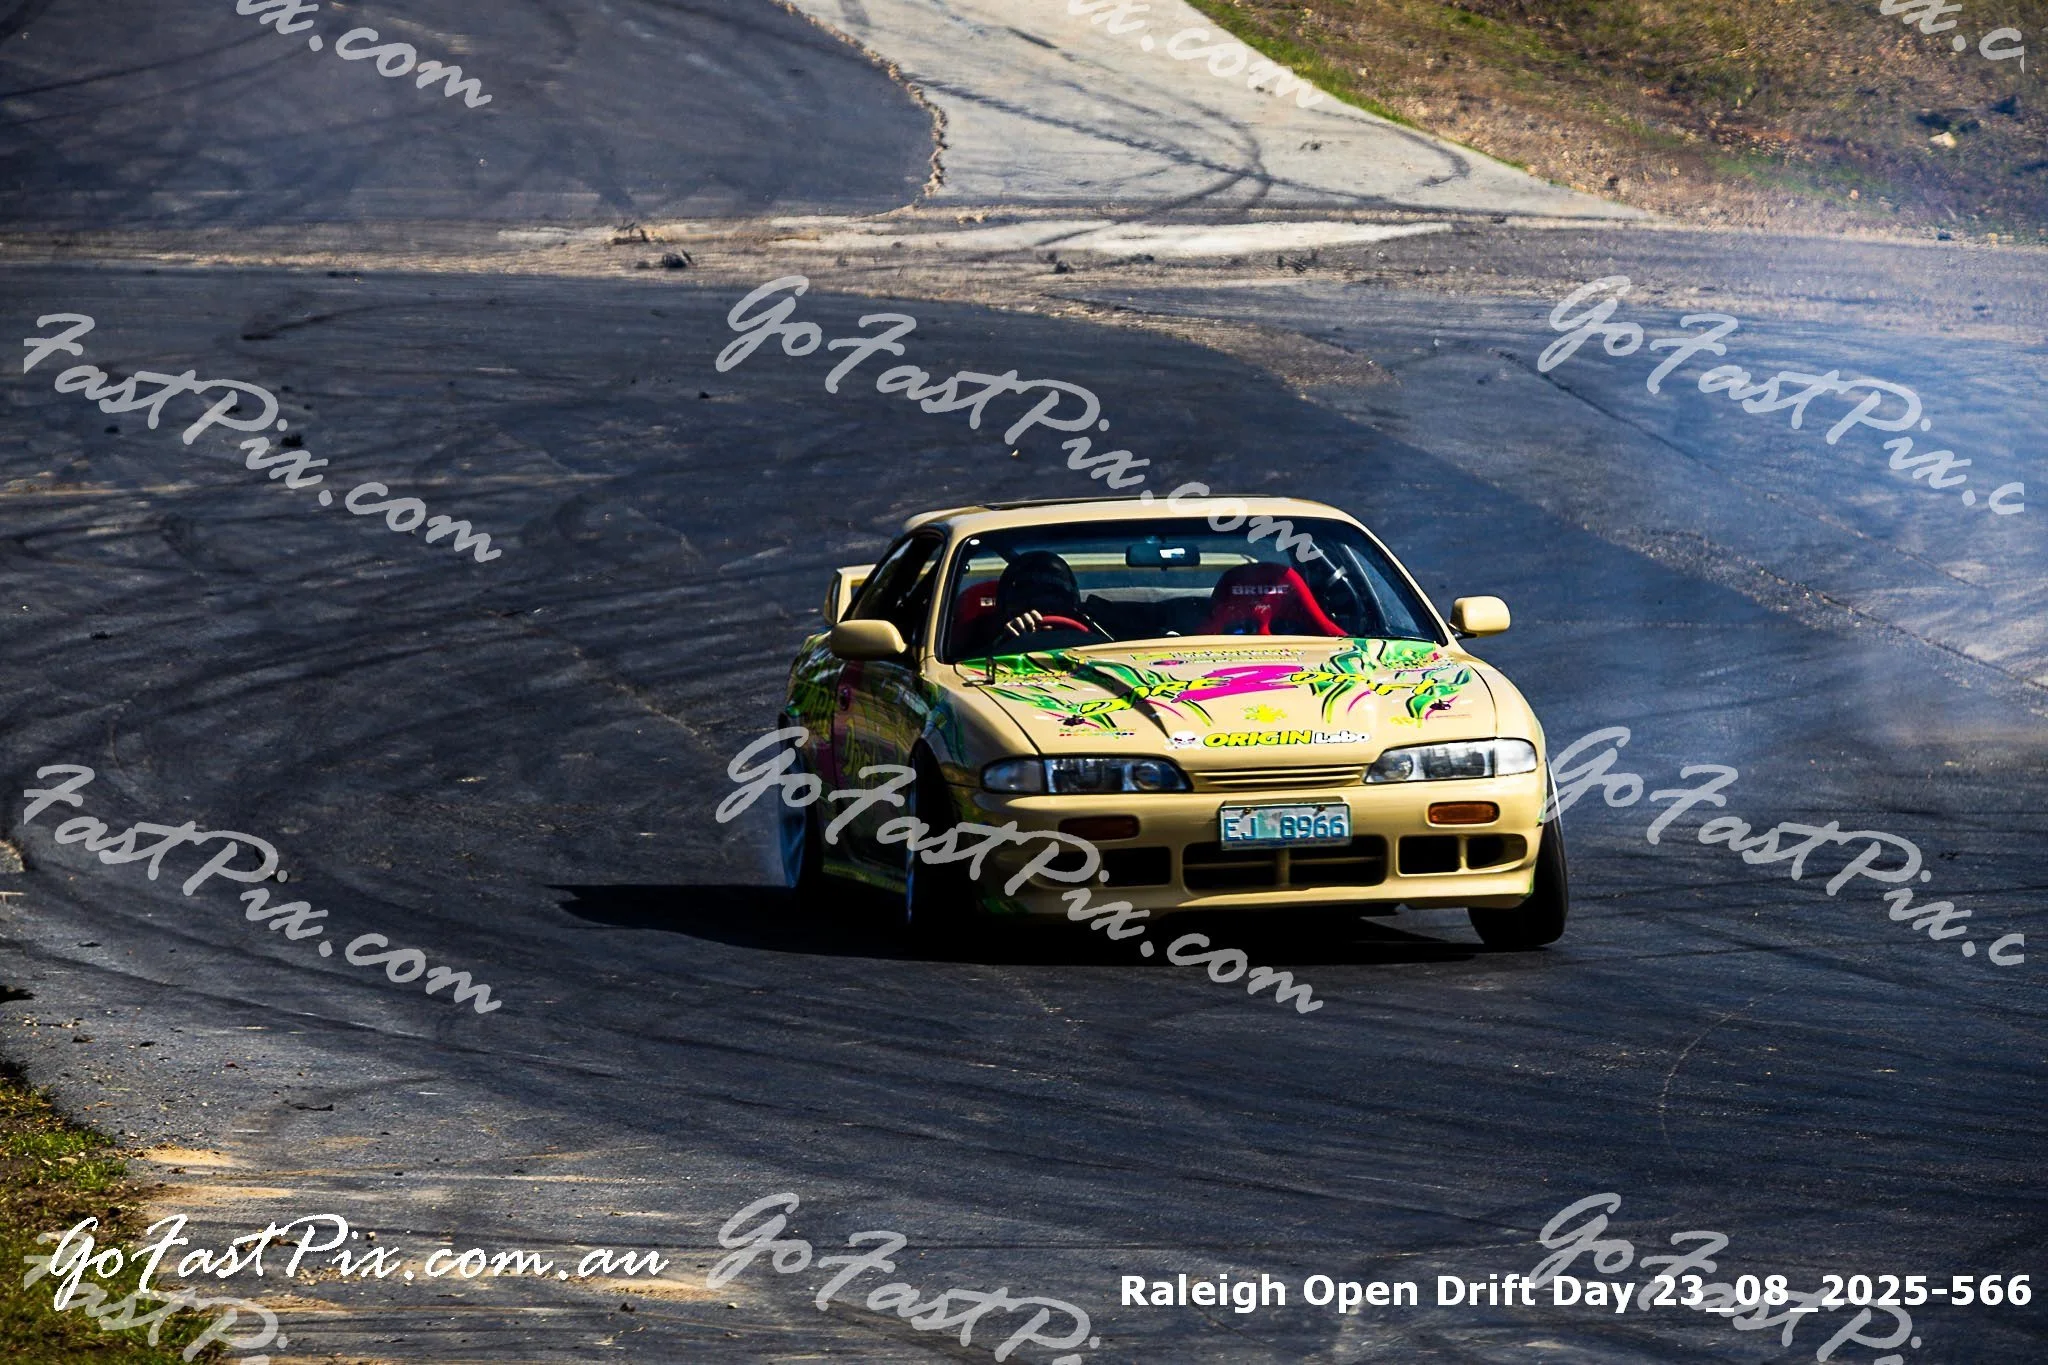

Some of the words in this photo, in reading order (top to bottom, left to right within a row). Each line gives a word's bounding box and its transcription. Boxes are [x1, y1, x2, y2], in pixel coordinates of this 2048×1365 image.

[1203, 730, 1312, 747] ORIGIN
[1223, 816, 1257, 841] EJ
[1280, 814, 1345, 839] 8966
